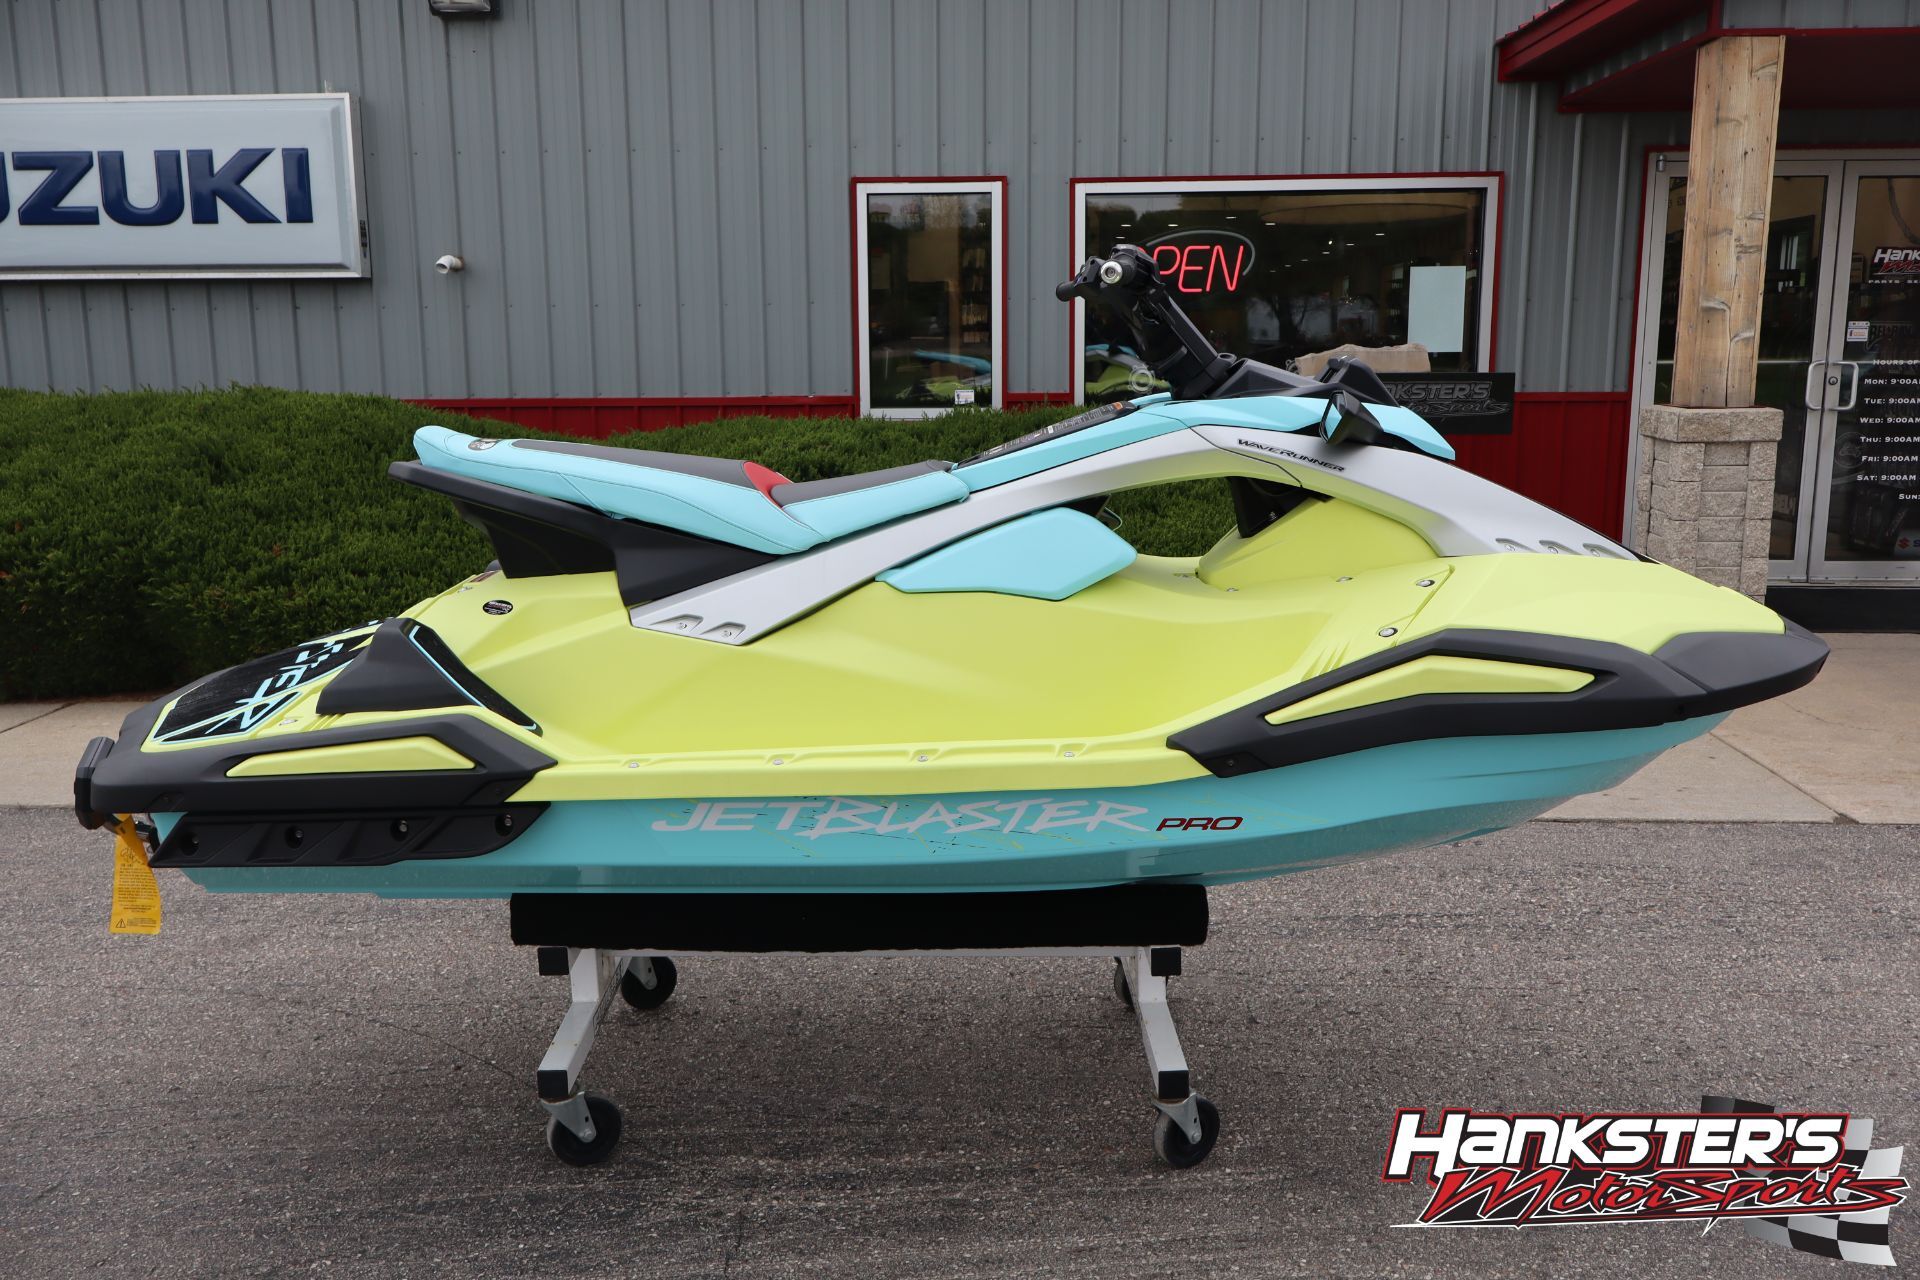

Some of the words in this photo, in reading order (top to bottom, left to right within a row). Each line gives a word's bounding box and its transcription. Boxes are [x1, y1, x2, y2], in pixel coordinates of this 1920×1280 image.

[0, 148, 313, 226] ZUKI
[1138, 245, 1244, 292] PEN
[1238, 438, 1345, 472] WAVERUNNER
[1156, 816, 1243, 832] PRO
